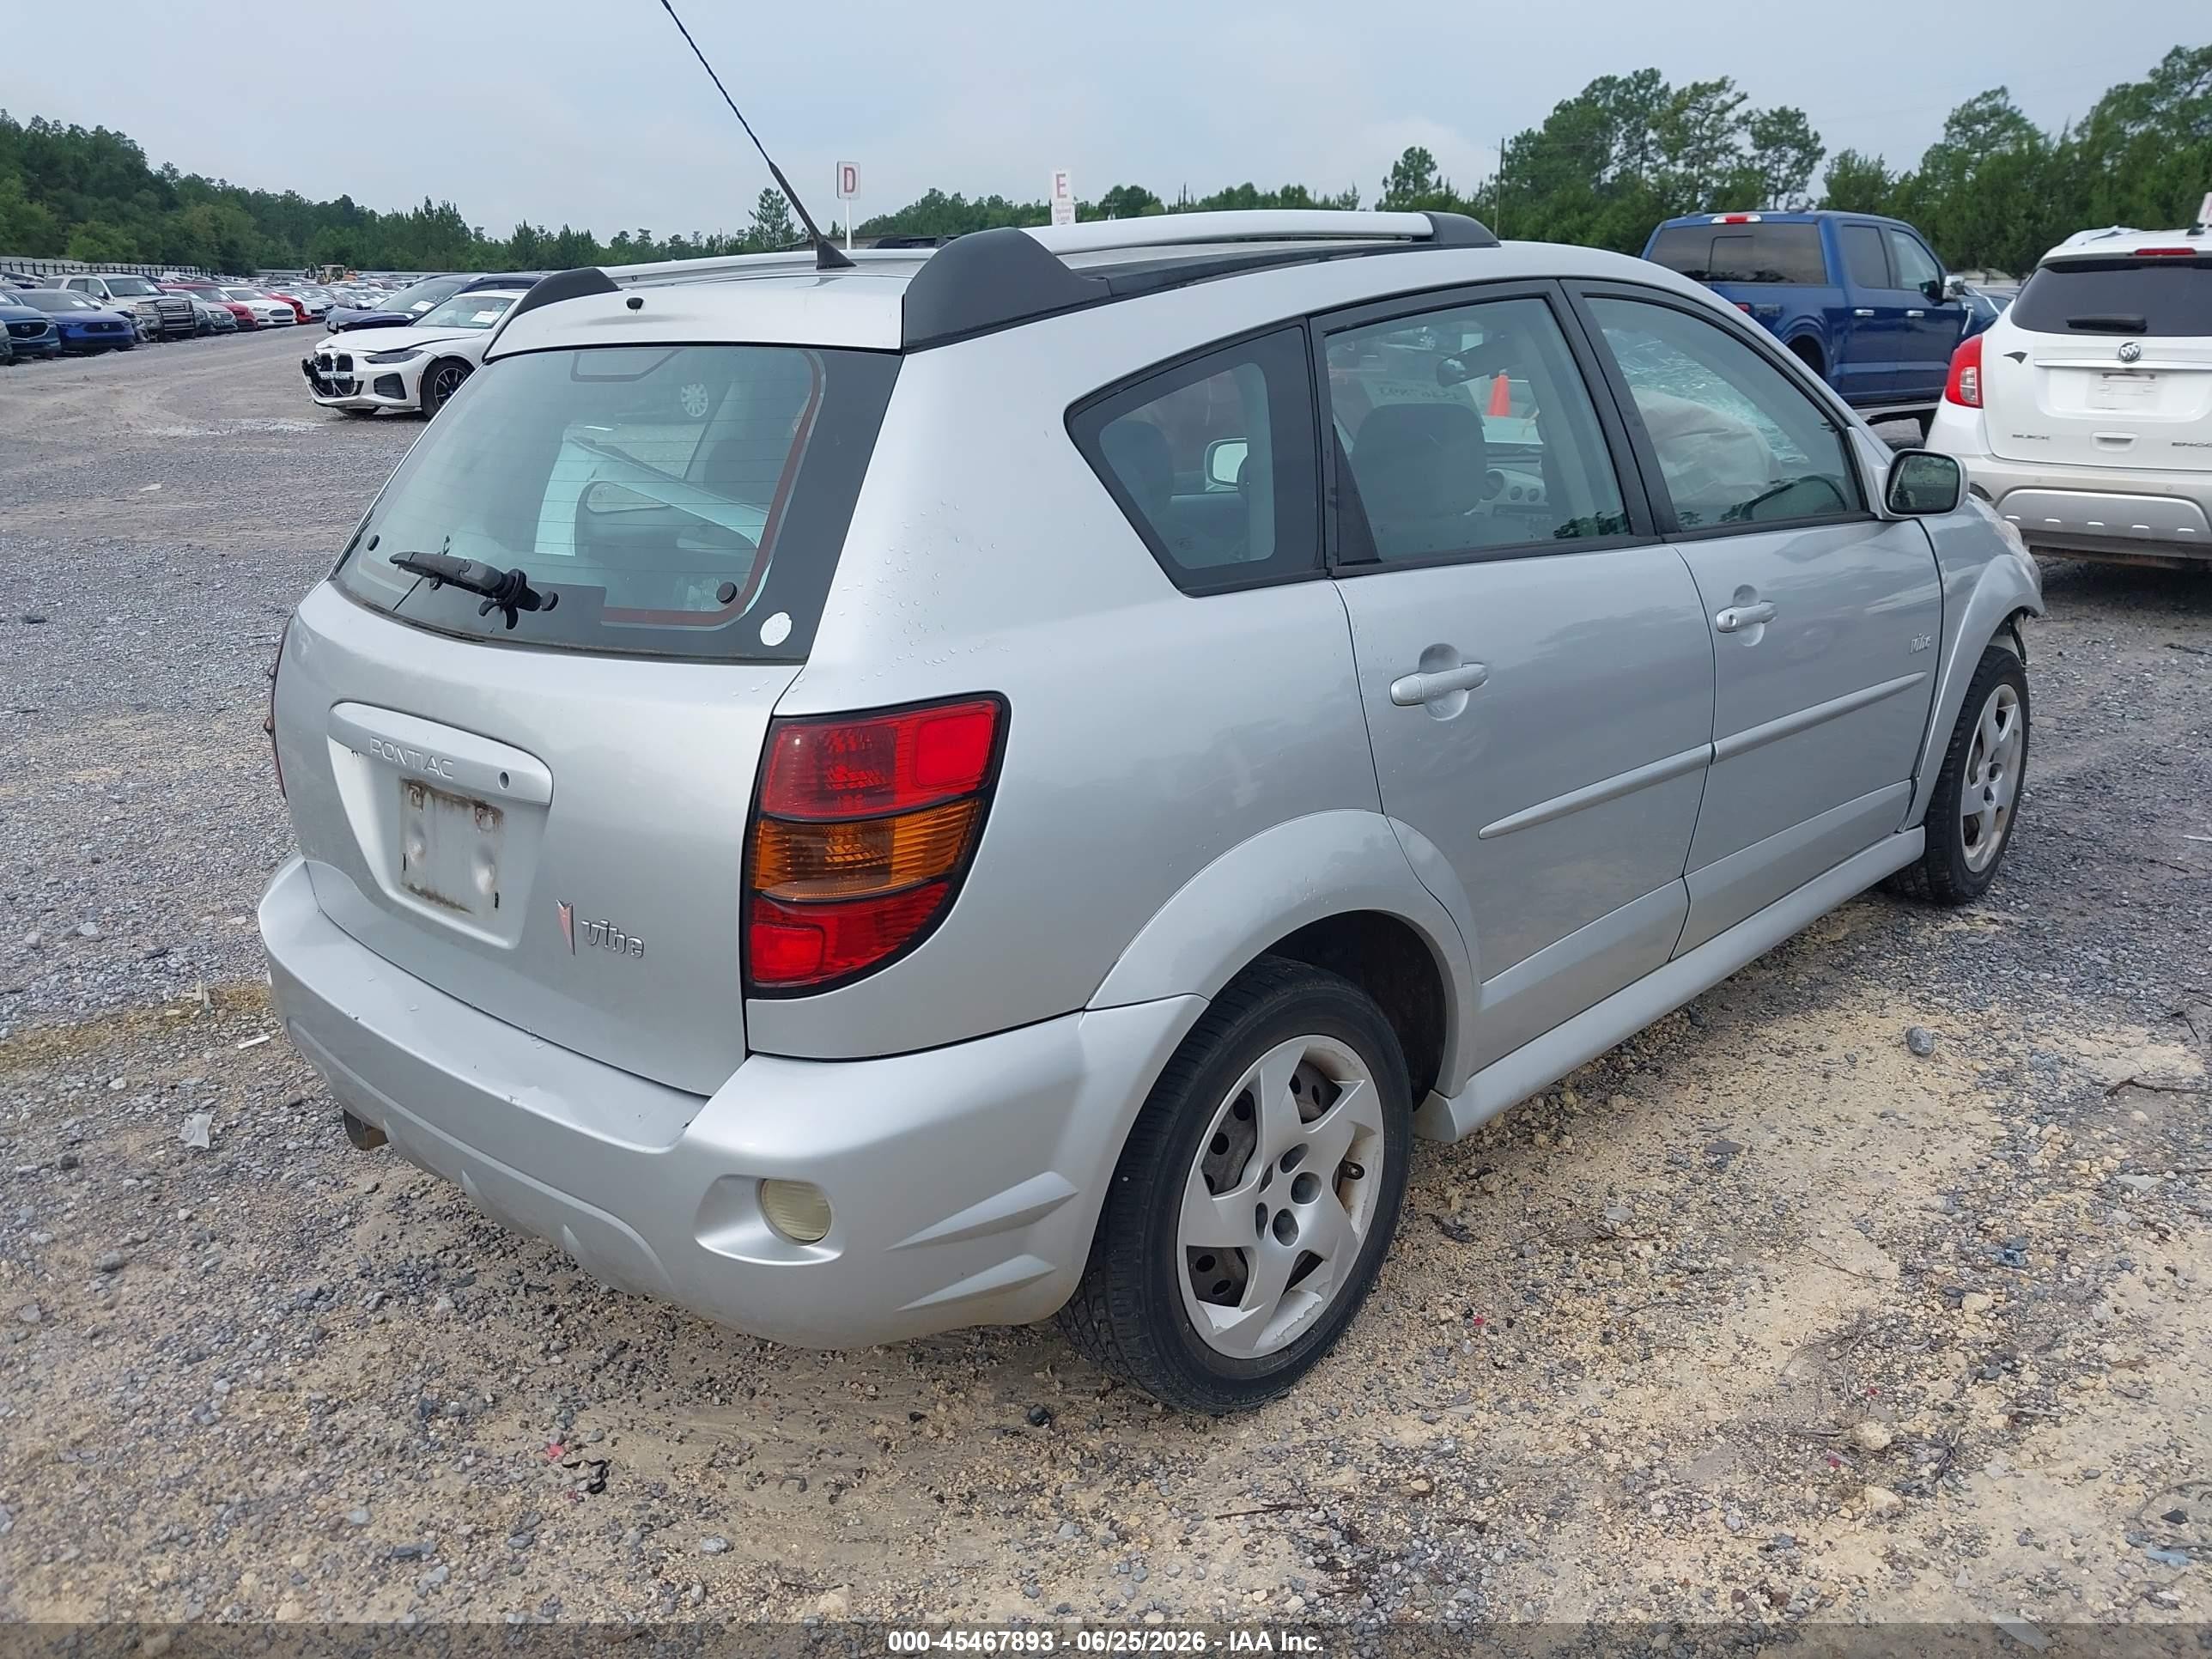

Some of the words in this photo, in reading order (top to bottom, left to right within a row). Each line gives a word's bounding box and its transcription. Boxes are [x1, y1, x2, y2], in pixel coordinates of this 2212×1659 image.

[843, 167, 856, 193] D
[1056, 173, 1067, 198] E
[369, 736, 454, 780] PONTIAC
[581, 919, 645, 959] vibe
